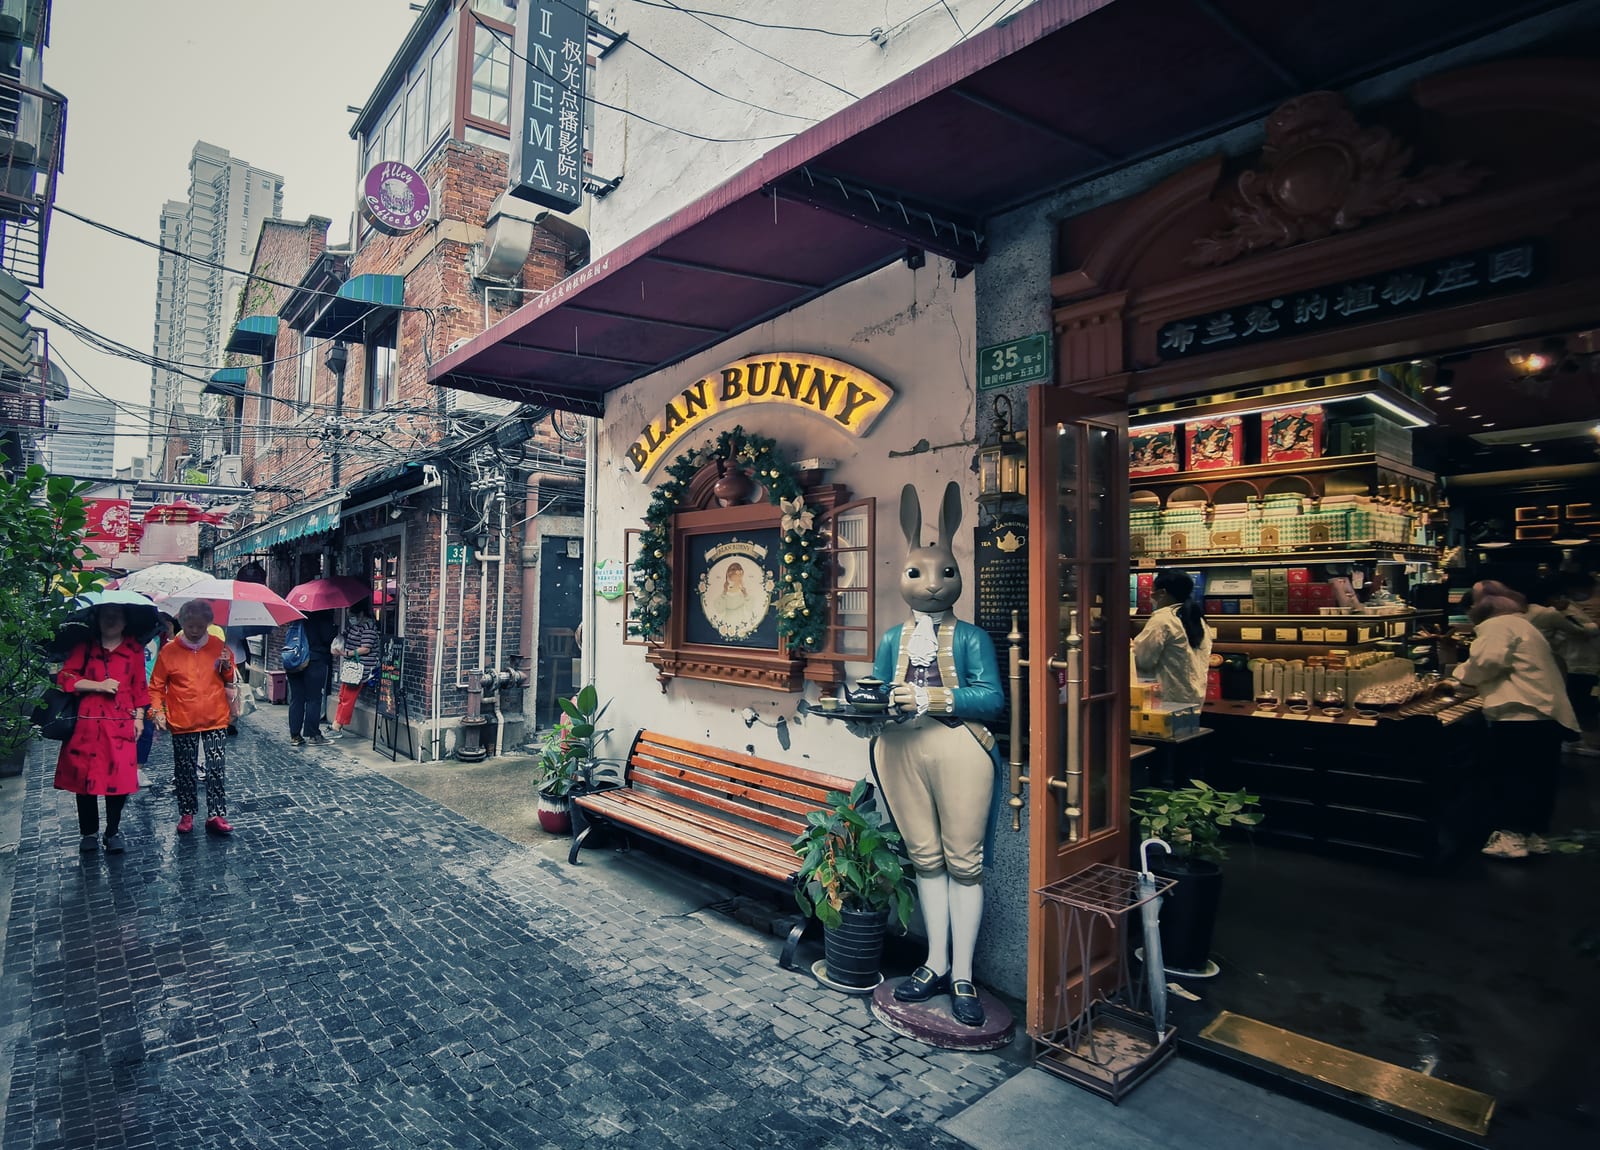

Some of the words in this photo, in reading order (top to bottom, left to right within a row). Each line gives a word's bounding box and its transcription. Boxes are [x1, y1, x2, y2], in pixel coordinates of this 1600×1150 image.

[557, 37, 582, 180] 极光点播影院
[381, 163, 414, 185] Alley
[555, 181, 569, 194] 2F
[367, 195, 400, 224] Coffee
[404, 216, 412, 225] &
[991, 346, 1018, 371] 35
[624, 378, 709, 473] BLAN
[719, 361, 877, 427] BUNNY
